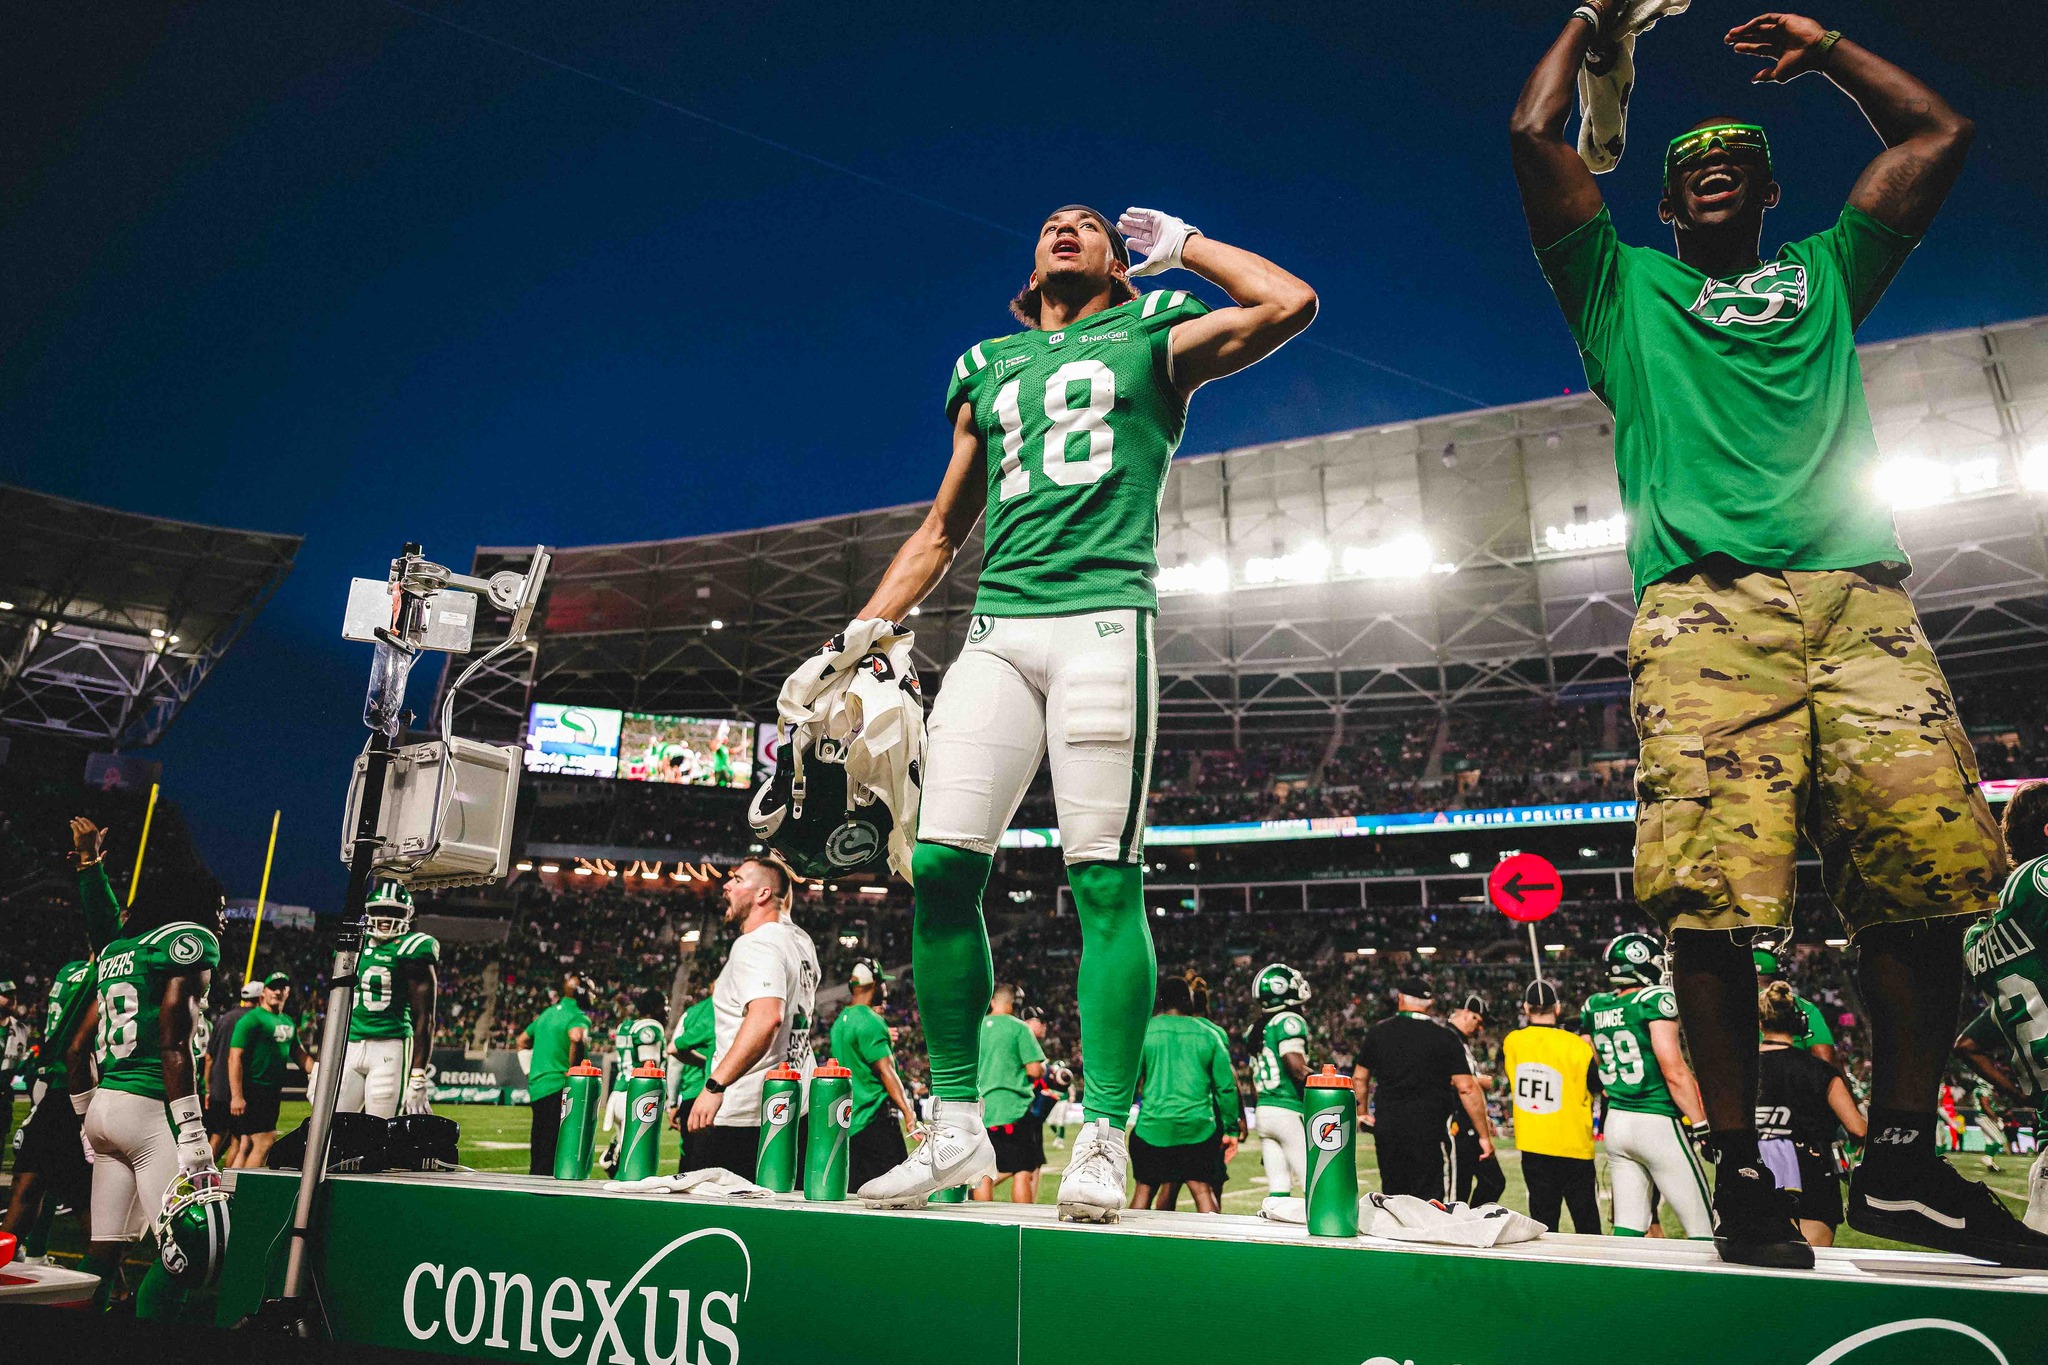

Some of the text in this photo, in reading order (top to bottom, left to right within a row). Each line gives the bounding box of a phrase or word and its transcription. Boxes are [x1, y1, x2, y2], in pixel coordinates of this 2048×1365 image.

[1089, 331, 1128, 343] NexGen
[992, 360, 1115, 502] 18
[1453, 810, 1515, 825] REGINA
[1522, 807, 1584, 822] POLICE
[1593, 1007, 1625, 1030] RUNGE
[1593, 1029, 1645, 1085] 39
[440, 1071, 497, 1086] REGINA
[1518, 1077, 1554, 1102] CFL
[403, 1228, 751, 1365] conexus
